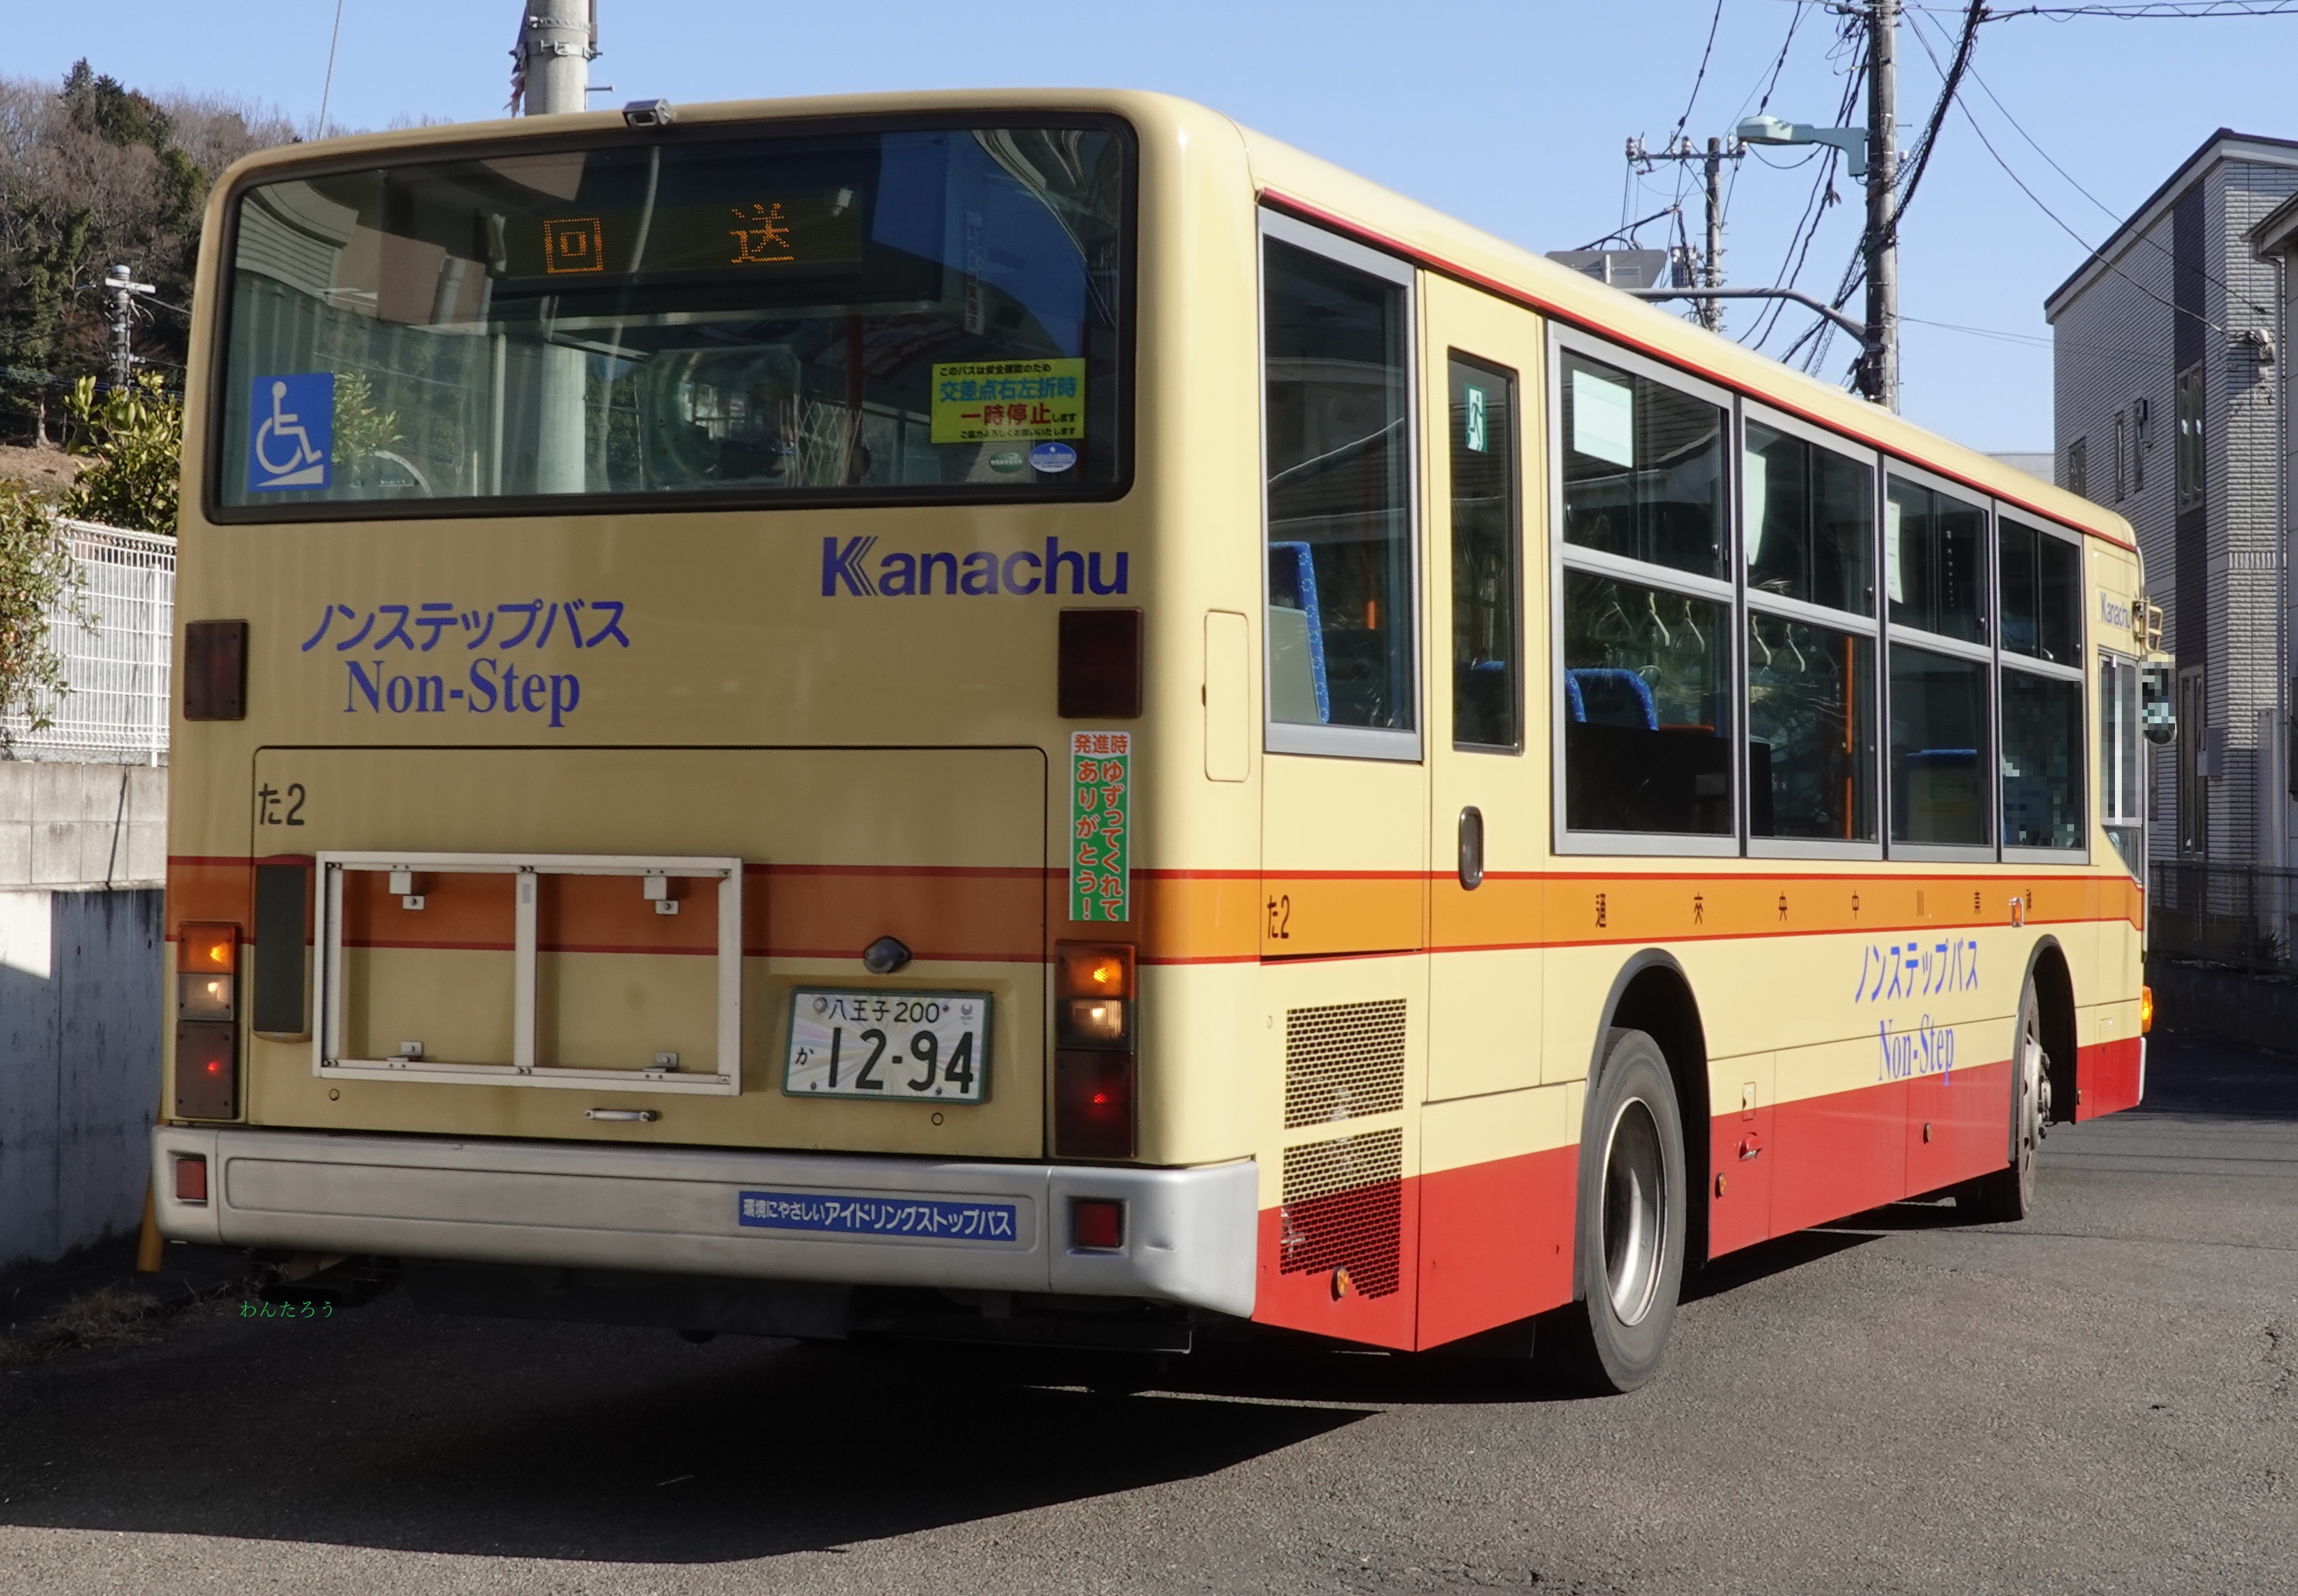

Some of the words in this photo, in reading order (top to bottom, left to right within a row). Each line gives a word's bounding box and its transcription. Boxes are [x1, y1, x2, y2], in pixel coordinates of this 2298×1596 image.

[940, 376, 1076, 402] 交差点右左折時
[822, 535, 1129, 596] Kanachu
[301, 598, 630, 652] ノンステップバス
[2100, 591, 2131, 630] Kanachu
[344, 658, 580, 727] Non-Step
[1074, 734, 1127, 754] 発進時
[259, 783, 305, 825] た2
[1100, 760, 1125, 921] ゆずってくれて
[1267, 894, 1290, 939] た2
[1855, 938, 1978, 1004] ノンステップバス
[795, 1046, 814, 1065] か
[828, 1026, 974, 1093] 12-94
[1878, 1013, 1954, 1086] Non-Step
